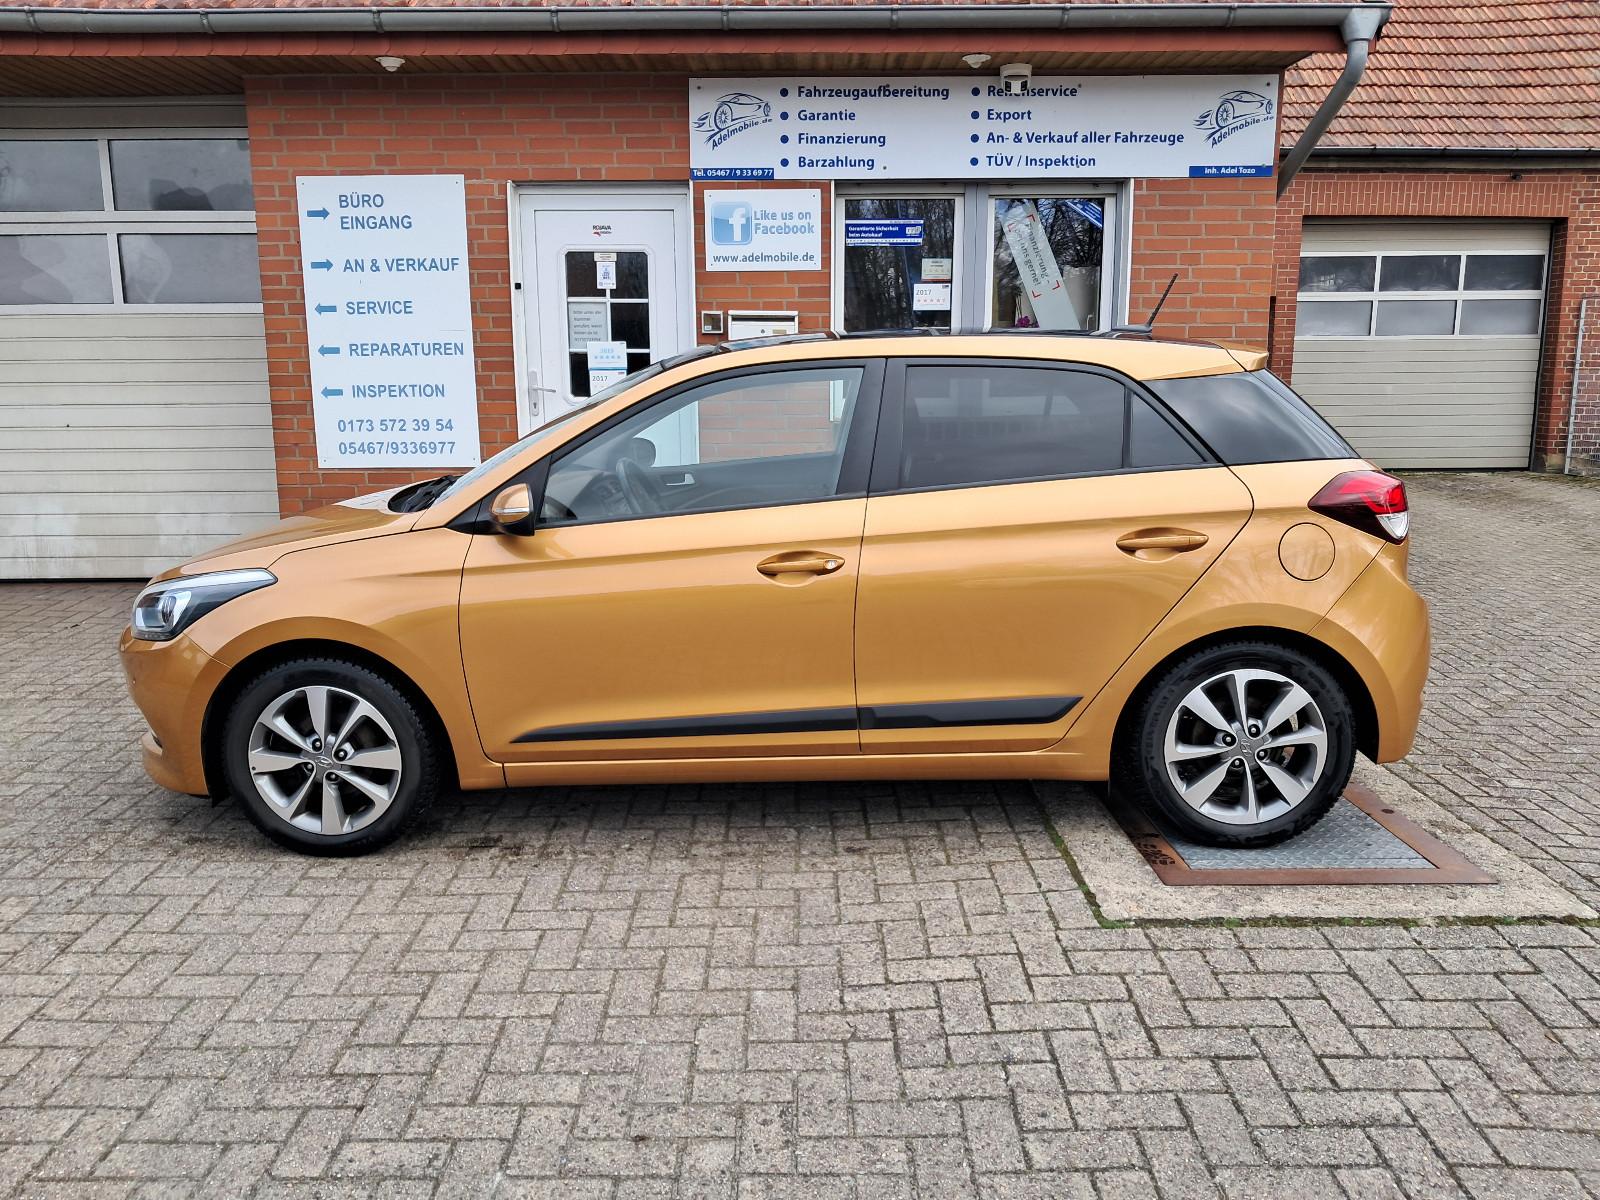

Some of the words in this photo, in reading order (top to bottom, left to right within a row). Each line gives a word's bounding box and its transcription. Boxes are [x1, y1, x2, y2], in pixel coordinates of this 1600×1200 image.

[798, 86, 950, 100] Fahrzeugaufbereitung
[798, 110, 856, 121] Garantie
[987, 109, 1032, 122] Export
[712, 118, 772, 151] Adelmobile.de
[986, 132, 1009, 143] An-
[1013, 132, 1023, 143] &
[1026, 131, 1078, 144] Verkauf
[1081, 132, 1111, 143] aller
[1114, 131, 1184, 146] Fahrzeuge
[1212, 116, 1274, 148] Adelmobile.de
[798, 133, 886, 147] Finanzierung
[798, 156, 875, 170] Barzahlung
[986, 154, 1013, 167] TÜV
[1017, 155, 1022, 167] /
[1025, 155, 1096, 169] Inspektion
[339, 192, 384, 208] BÜRO
[340, 215, 412, 230] EINGANG
[753, 210, 777, 221] Like
[781, 212, 794, 220] us
[798, 211, 811, 220] on
[754, 222, 814, 234] Facebook
[343, 259, 364, 272] AN
[370, 259, 380, 272] &
[385, 257, 459, 272] VERKAUF
[713, 253, 814, 263] www.adelmobile.de
[346, 301, 413, 315] SERVICE
[349, 342, 464, 357] REPARATUREN
[352, 384, 445, 398] INSPEKTION
[338, 420, 374, 432] 0173
[380, 419, 406, 432] 572
[412, 419, 430, 432] 39
[435, 419, 453, 431] 54
[339, 441, 456, 455] 05467/9336977
